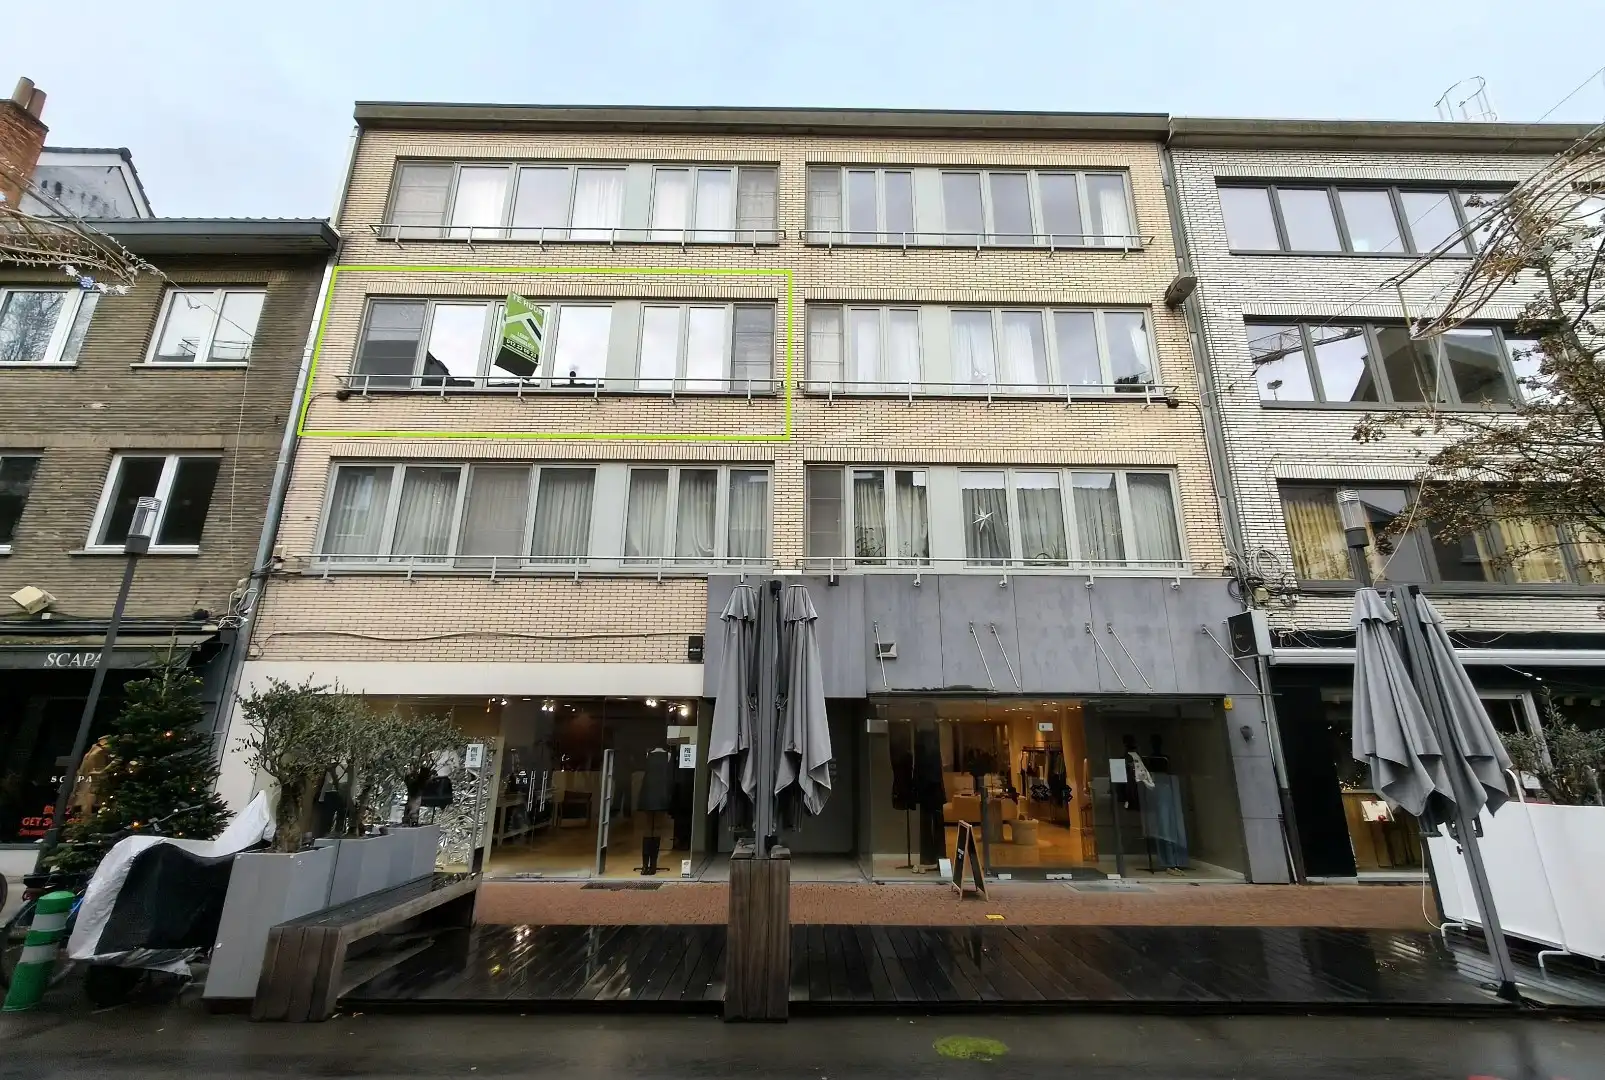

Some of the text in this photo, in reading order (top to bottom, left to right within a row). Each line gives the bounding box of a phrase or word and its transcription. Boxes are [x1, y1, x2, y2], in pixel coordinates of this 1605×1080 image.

[512, 293, 544, 317] TE HUUR
[50, 775, 93, 783] SCPA
[22, 817, 42, 826] GET
